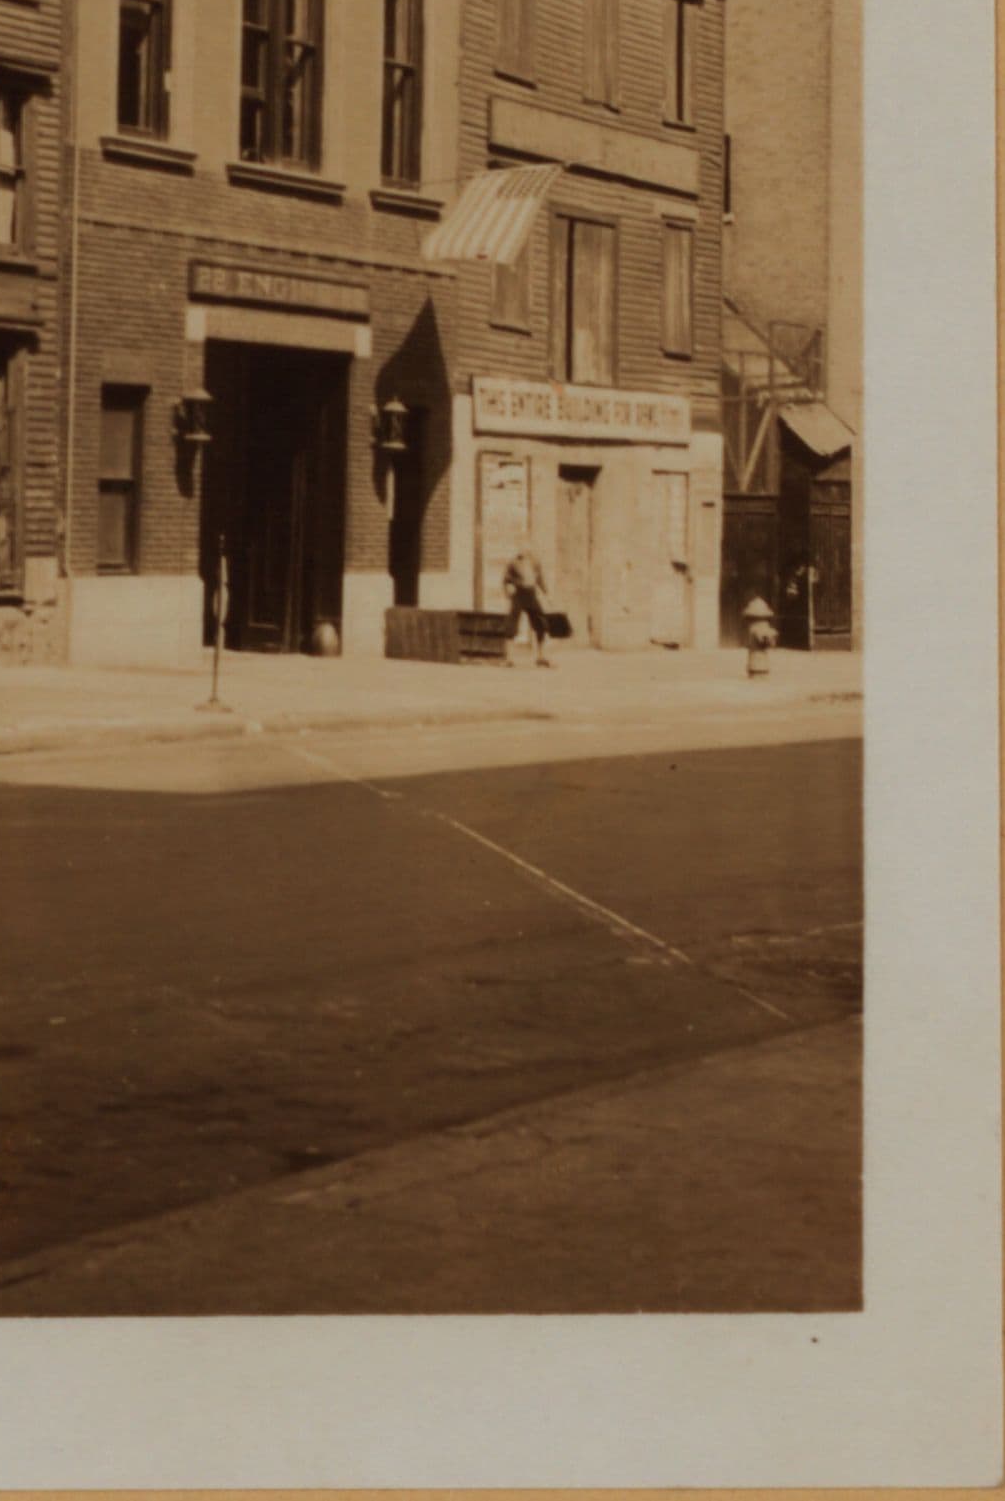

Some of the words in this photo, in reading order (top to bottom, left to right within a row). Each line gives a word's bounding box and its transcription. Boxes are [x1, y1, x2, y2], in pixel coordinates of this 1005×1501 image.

[236, 271, 328, 308] ENGIN
[510, 390, 551, 420] ENTIRE
[556, 393, 611, 425] BUILDING
